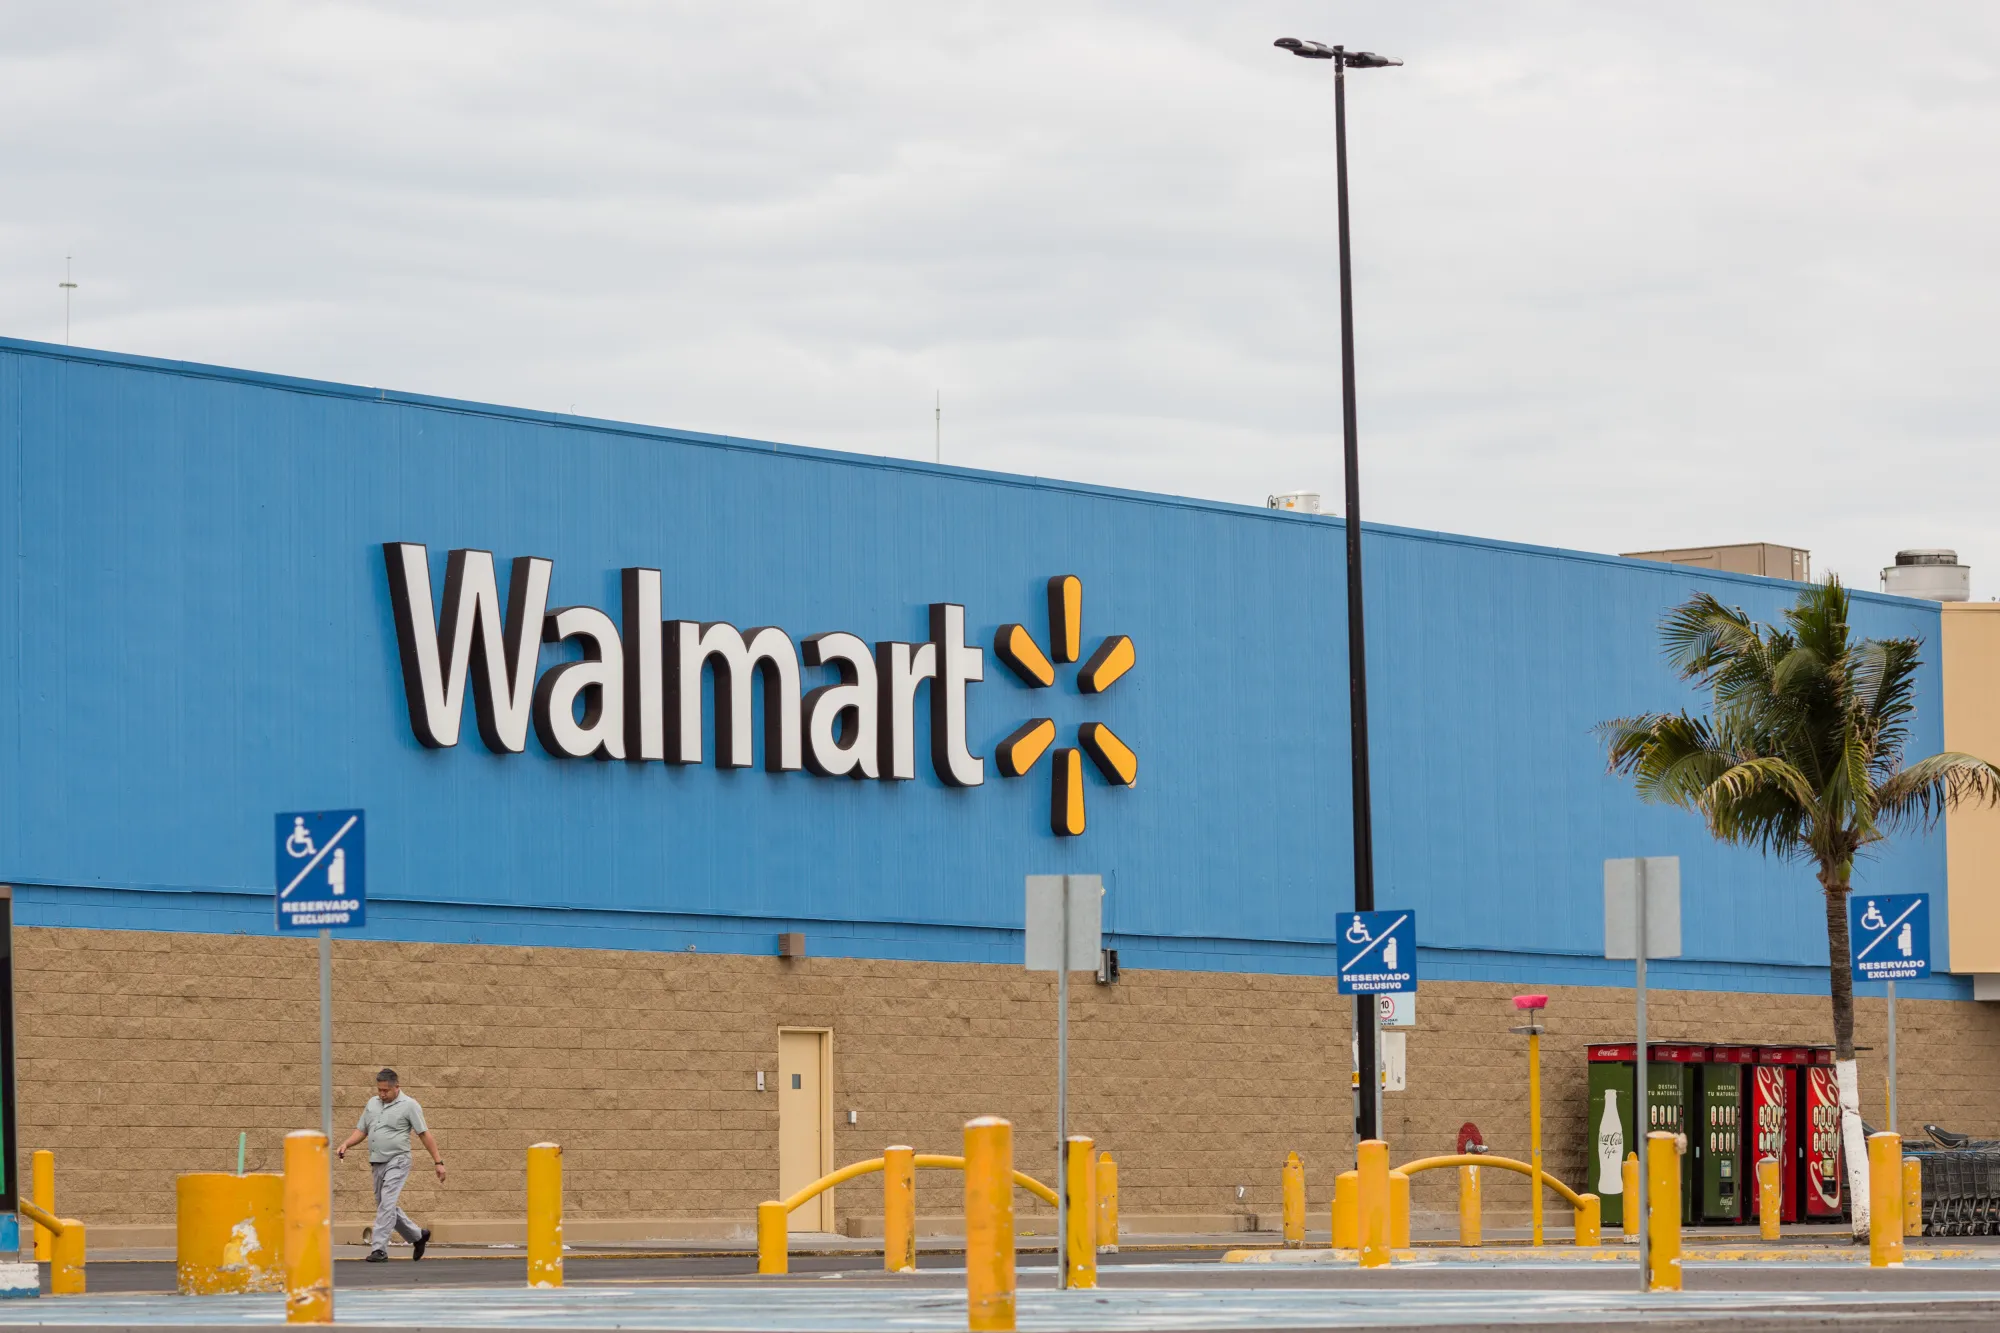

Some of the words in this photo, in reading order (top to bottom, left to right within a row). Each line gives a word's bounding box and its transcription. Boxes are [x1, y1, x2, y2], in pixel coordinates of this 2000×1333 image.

[383, 542, 984, 787] Walmart
[282, 900, 359, 912] RESERVADO
[292, 913, 350, 925] EXCLUSIVO
[1859, 960, 1925, 970] RESERVADO
[1343, 973, 1410, 982] RESERVADO
[1867, 970, 1917, 979] EXCLUSIVO
[1352, 982, 1402, 991] EXCLUSIVO
[1381, 1000, 1389, 1009] 10
